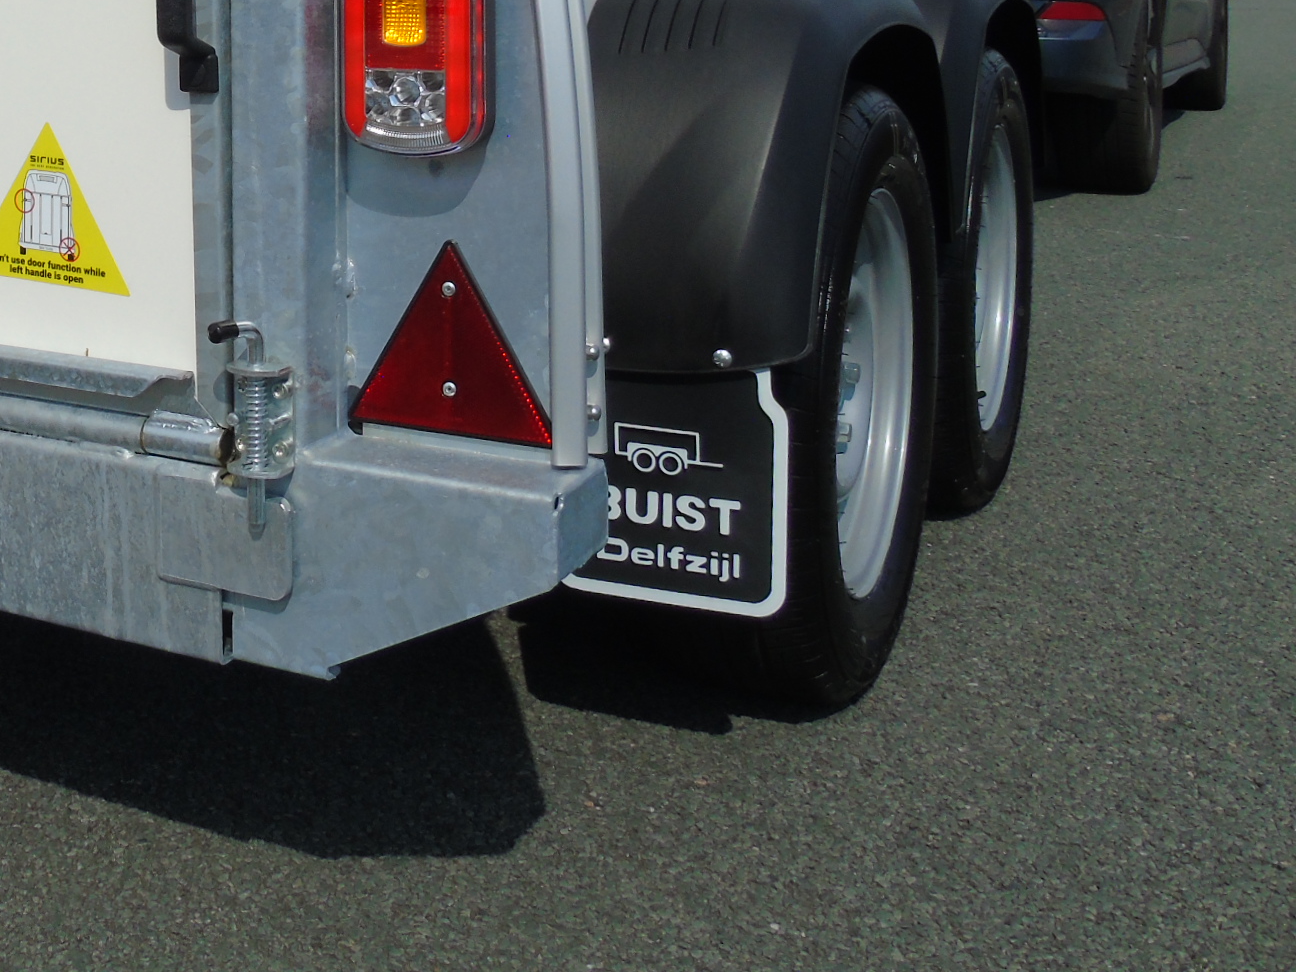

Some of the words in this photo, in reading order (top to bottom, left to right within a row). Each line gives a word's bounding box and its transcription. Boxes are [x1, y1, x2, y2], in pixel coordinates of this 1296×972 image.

[9, 264, 24, 275] left
[25, 267, 52, 279] handle
[54, 271, 61, 280] is
[63, 274, 84, 284] open
[11, 256, 25, 265] use
[27, 257, 45, 268] door
[48, 260, 82, 274] function
[83, 266, 106, 278] while
[597, 536, 741, 583] Delfzijl
